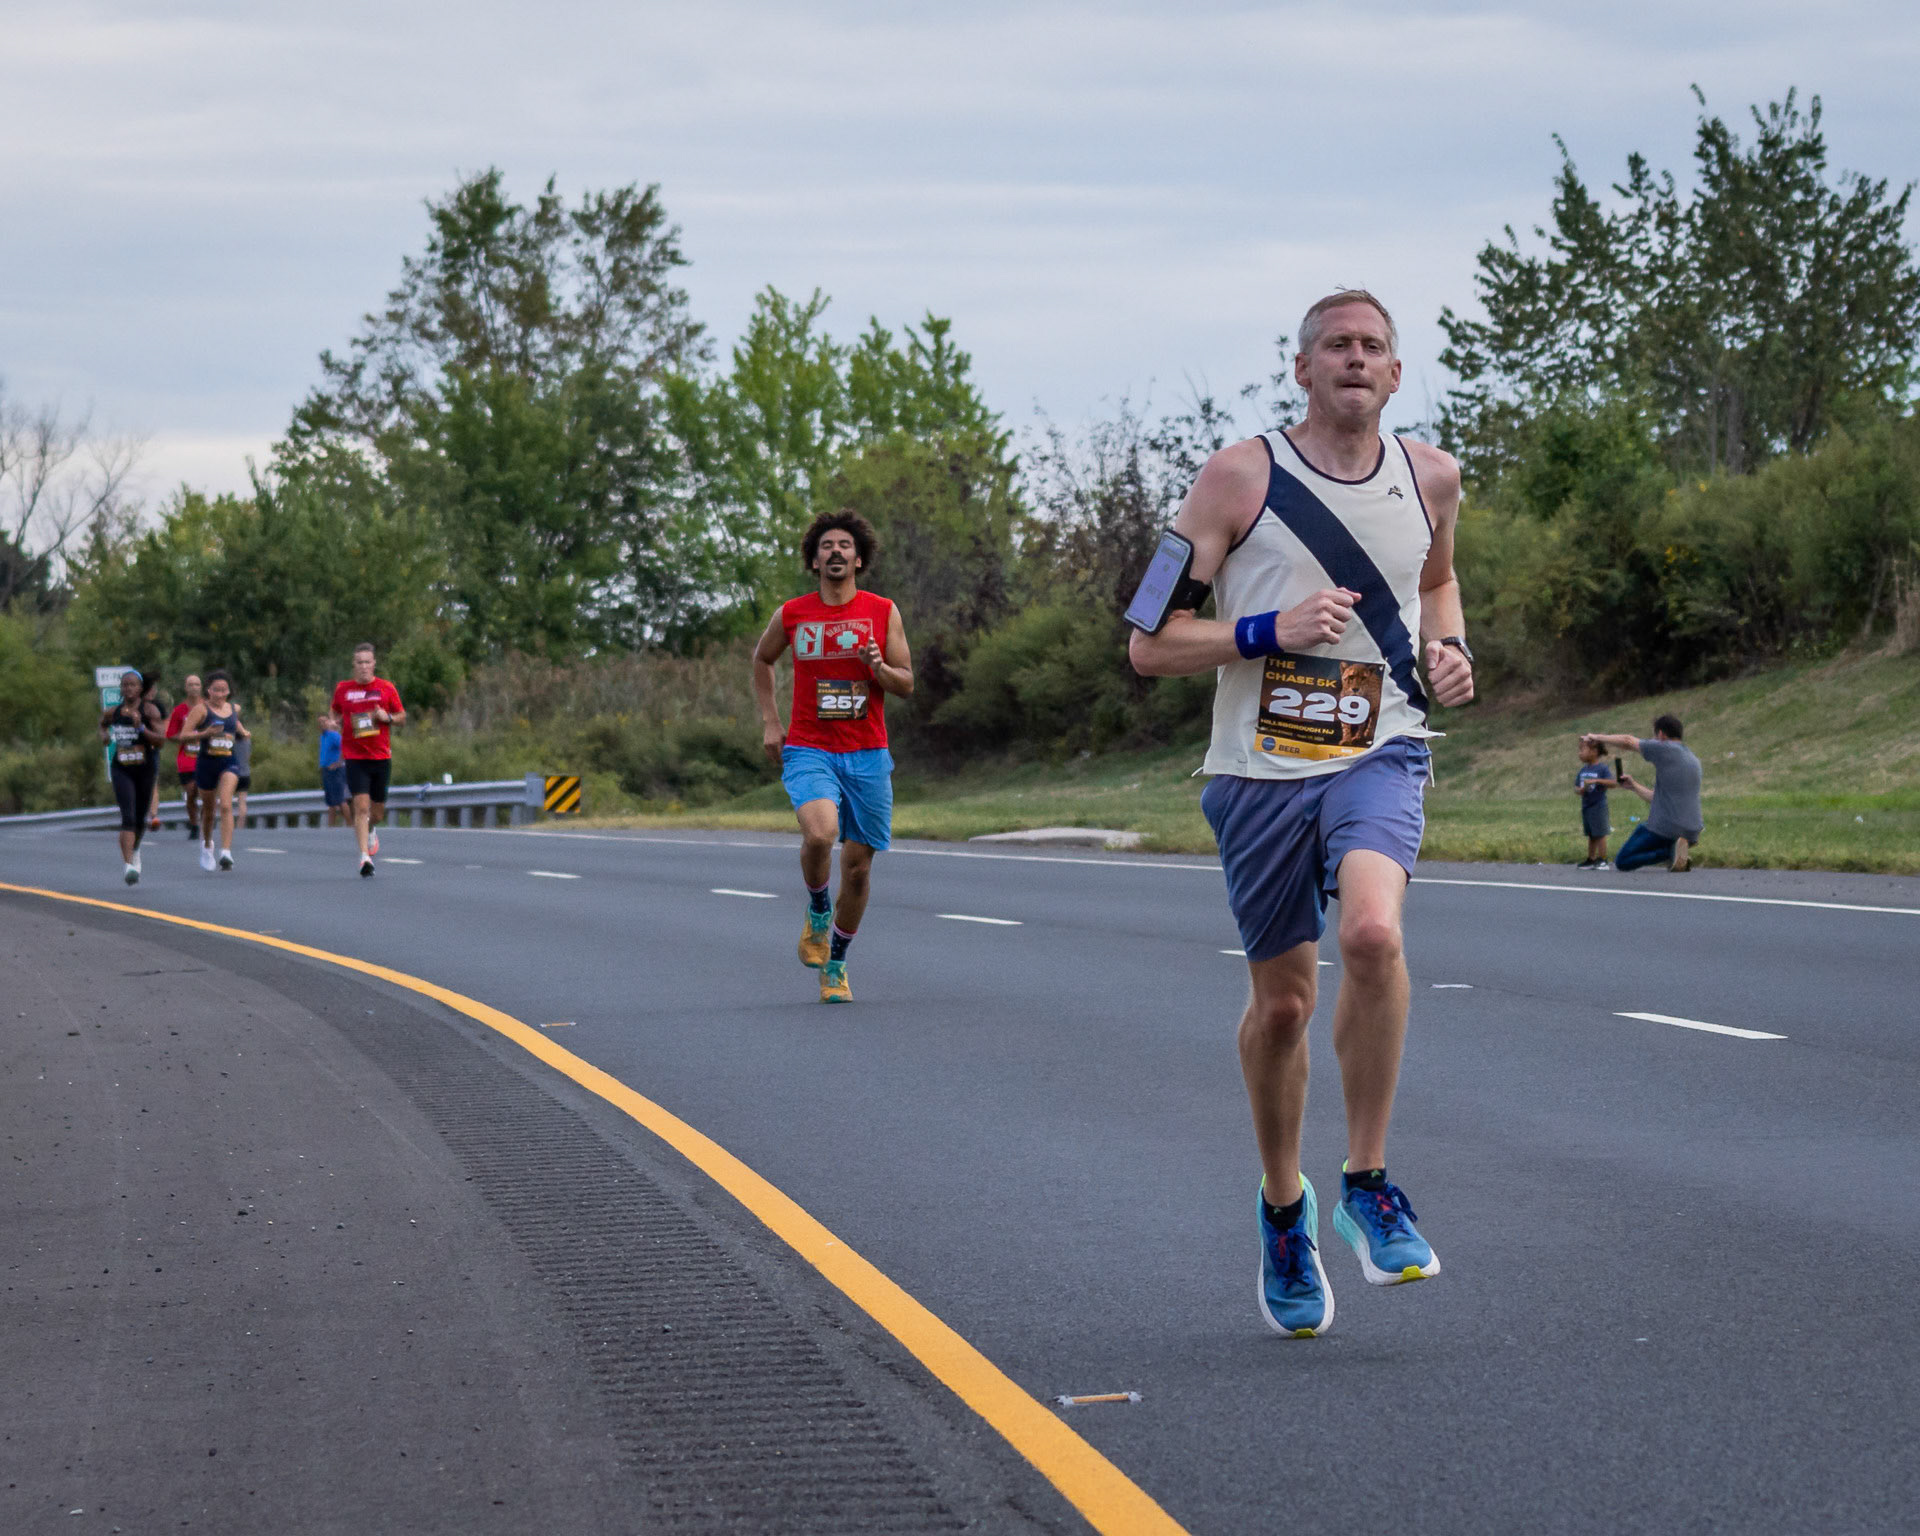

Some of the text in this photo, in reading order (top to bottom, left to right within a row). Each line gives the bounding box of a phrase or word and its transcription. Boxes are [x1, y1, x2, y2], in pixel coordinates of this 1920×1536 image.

[1268, 658, 1296, 670] THE
[1265, 671, 1337, 688] CHASE 5K
[822, 695, 866, 709] 257
[1268, 687, 1371, 725] 229
[1260, 718, 1321, 734] HILLSBOROUGH
[1322, 727, 1334, 735] NJ
[1279, 744, 1300, 754] BEER
